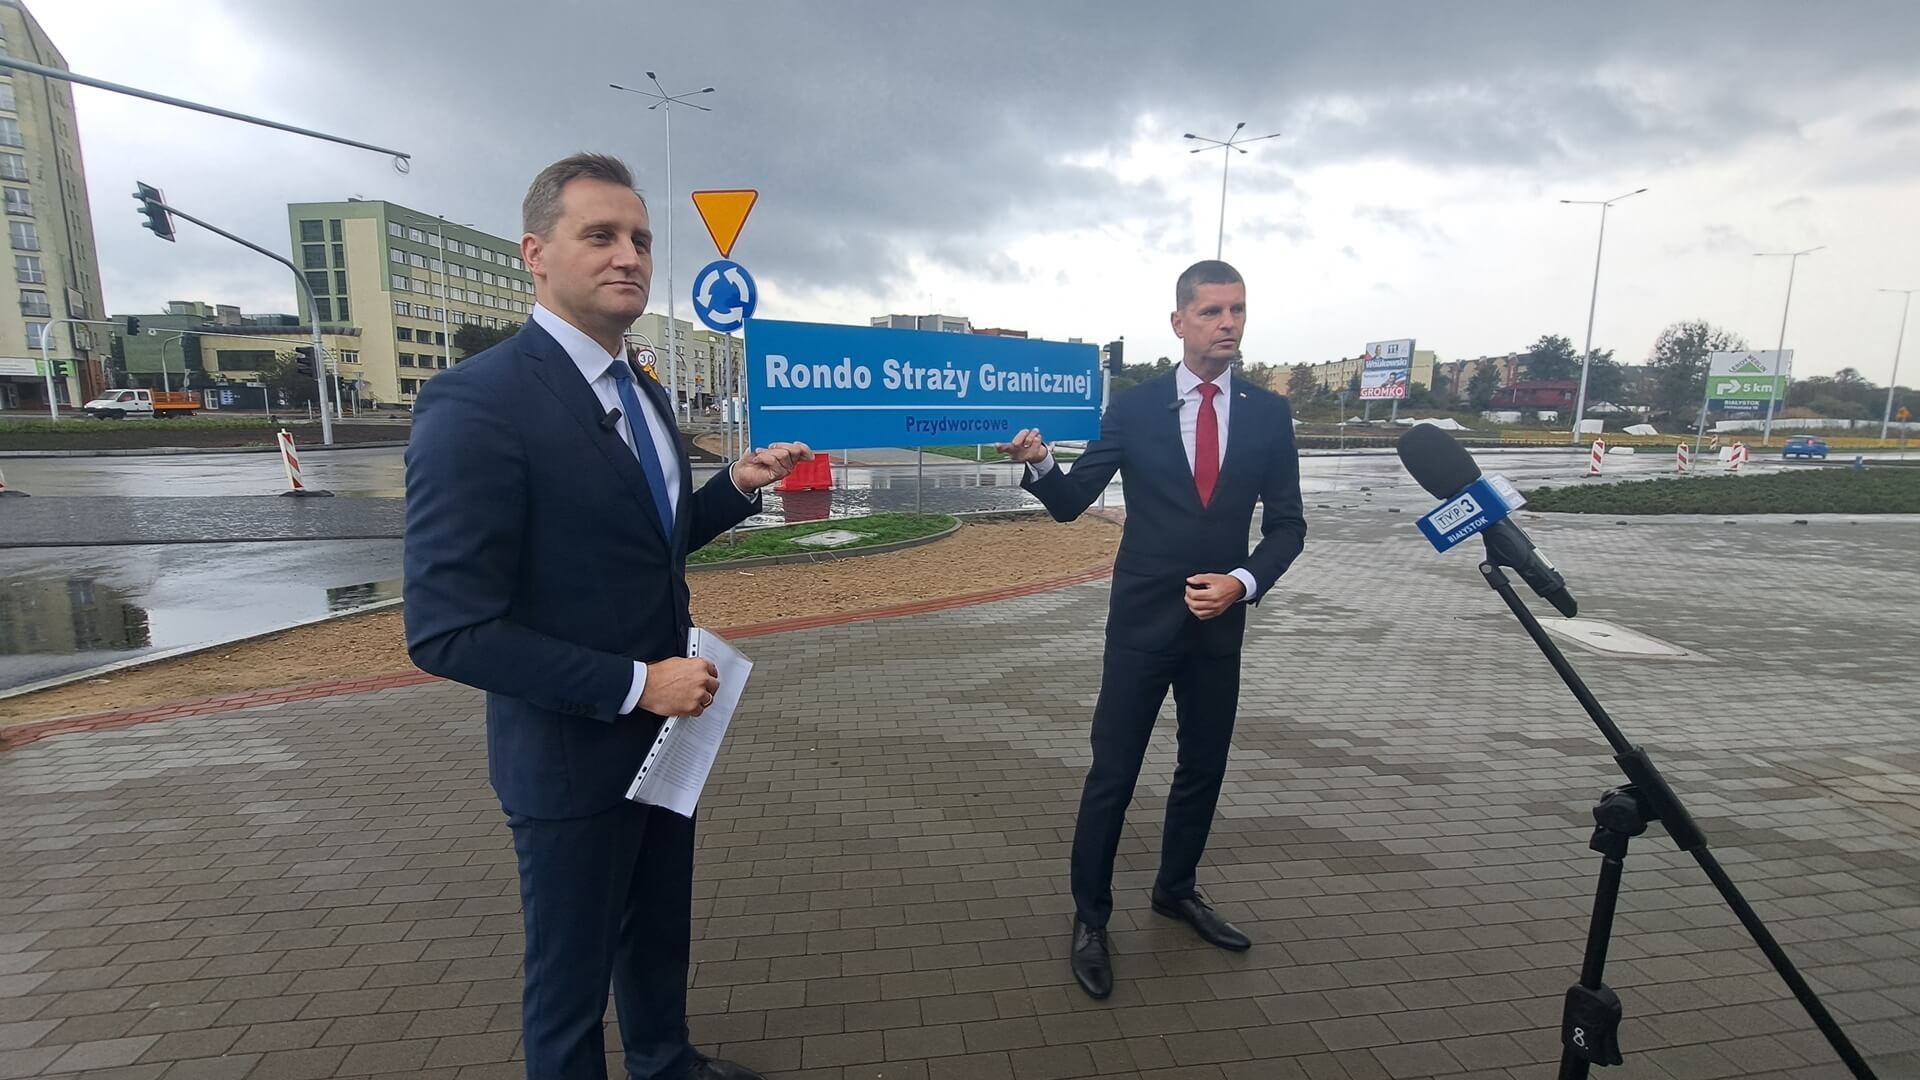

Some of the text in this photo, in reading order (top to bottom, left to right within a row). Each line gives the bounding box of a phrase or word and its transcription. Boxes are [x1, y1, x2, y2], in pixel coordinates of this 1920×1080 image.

[640, 354, 654, 363] 30
[765, 354, 1092, 400] Rondo Straży Granicznej
[1360, 386, 1404, 396] GROMKO
[1743, 383, 1773, 392] 5 km
[905, 415, 1009, 435] Przydworcowe
[1438, 498, 1475, 527] TVP 3
[1447, 515, 1489, 543] BIAŁYSTOK
